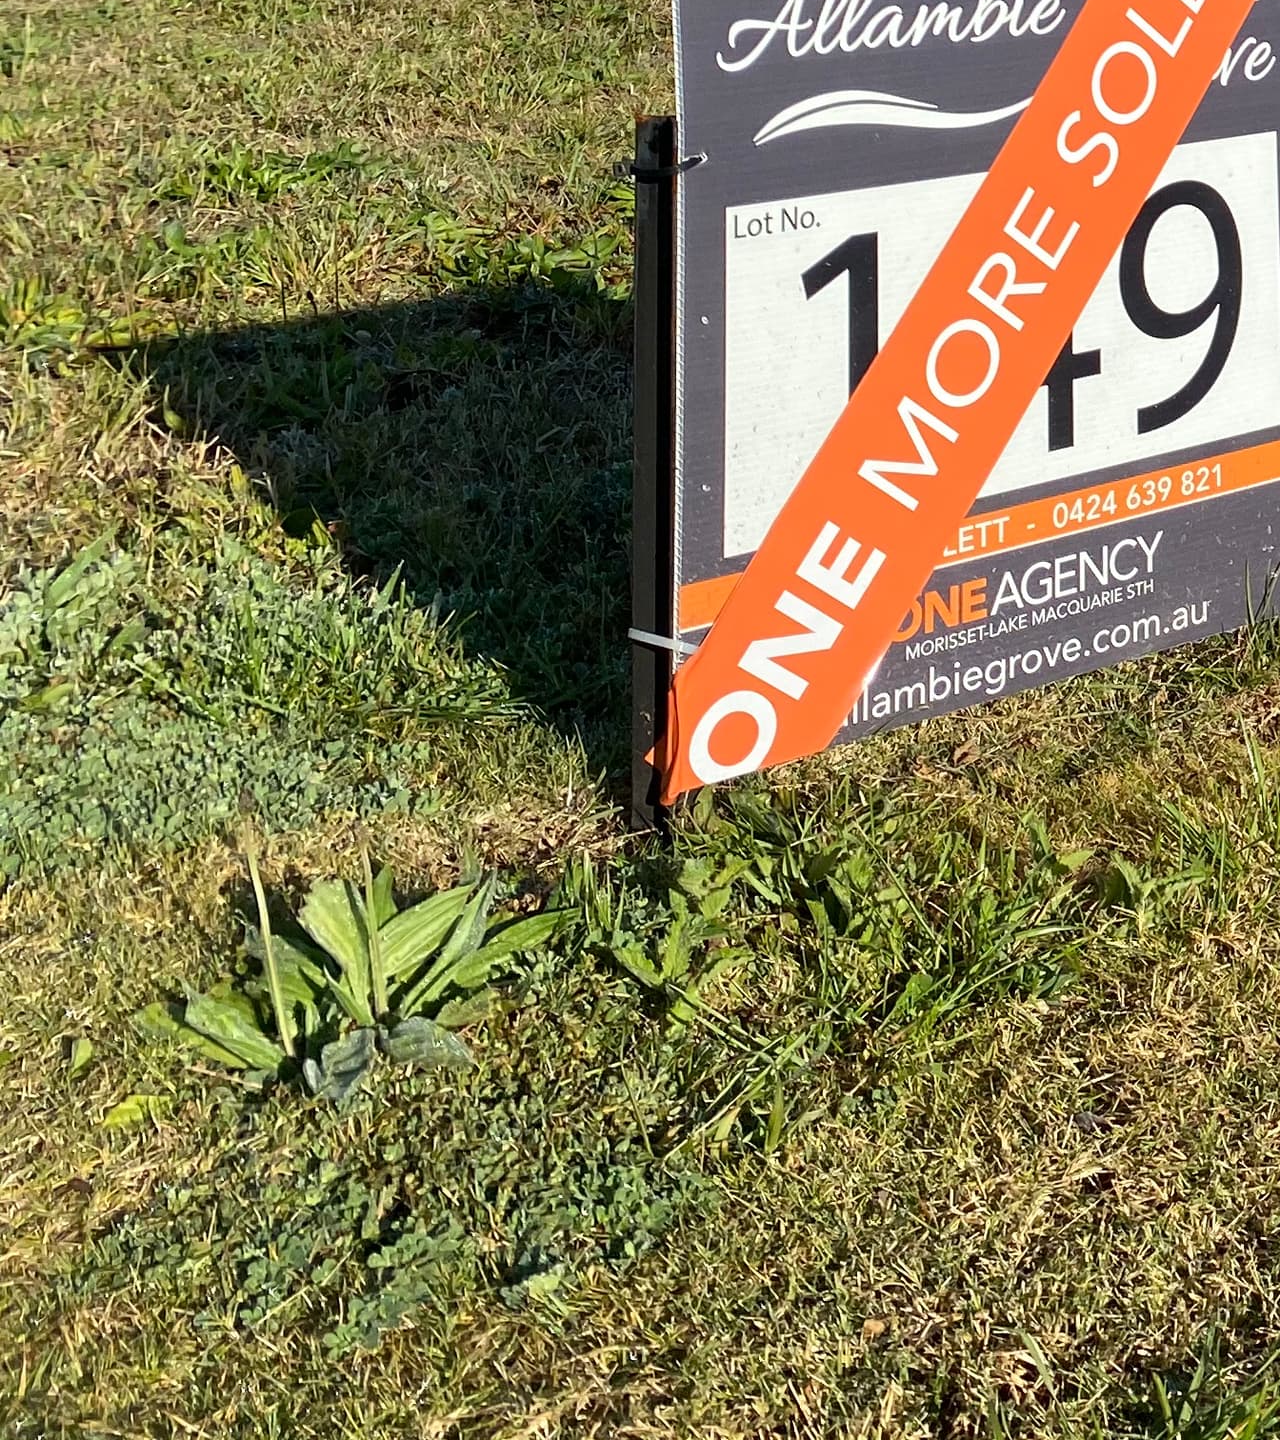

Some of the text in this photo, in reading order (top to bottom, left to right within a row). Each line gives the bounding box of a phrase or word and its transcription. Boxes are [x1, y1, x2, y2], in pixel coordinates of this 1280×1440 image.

[733, 206, 822, 239] Lot No.
[688, 519, 887, 785] ONE
[857, 185, 1081, 512] MORE
[1052, 489, 1118, 529] 0424
[1126, 476, 1172, 510] 639
[1180, 463, 1223, 496] 821
[1031, 589, 1124, 626] MACQUARIE
[1126, 579, 1155, 603] STH
[841, 600, 1209, 727] llambiegrove.com.au
